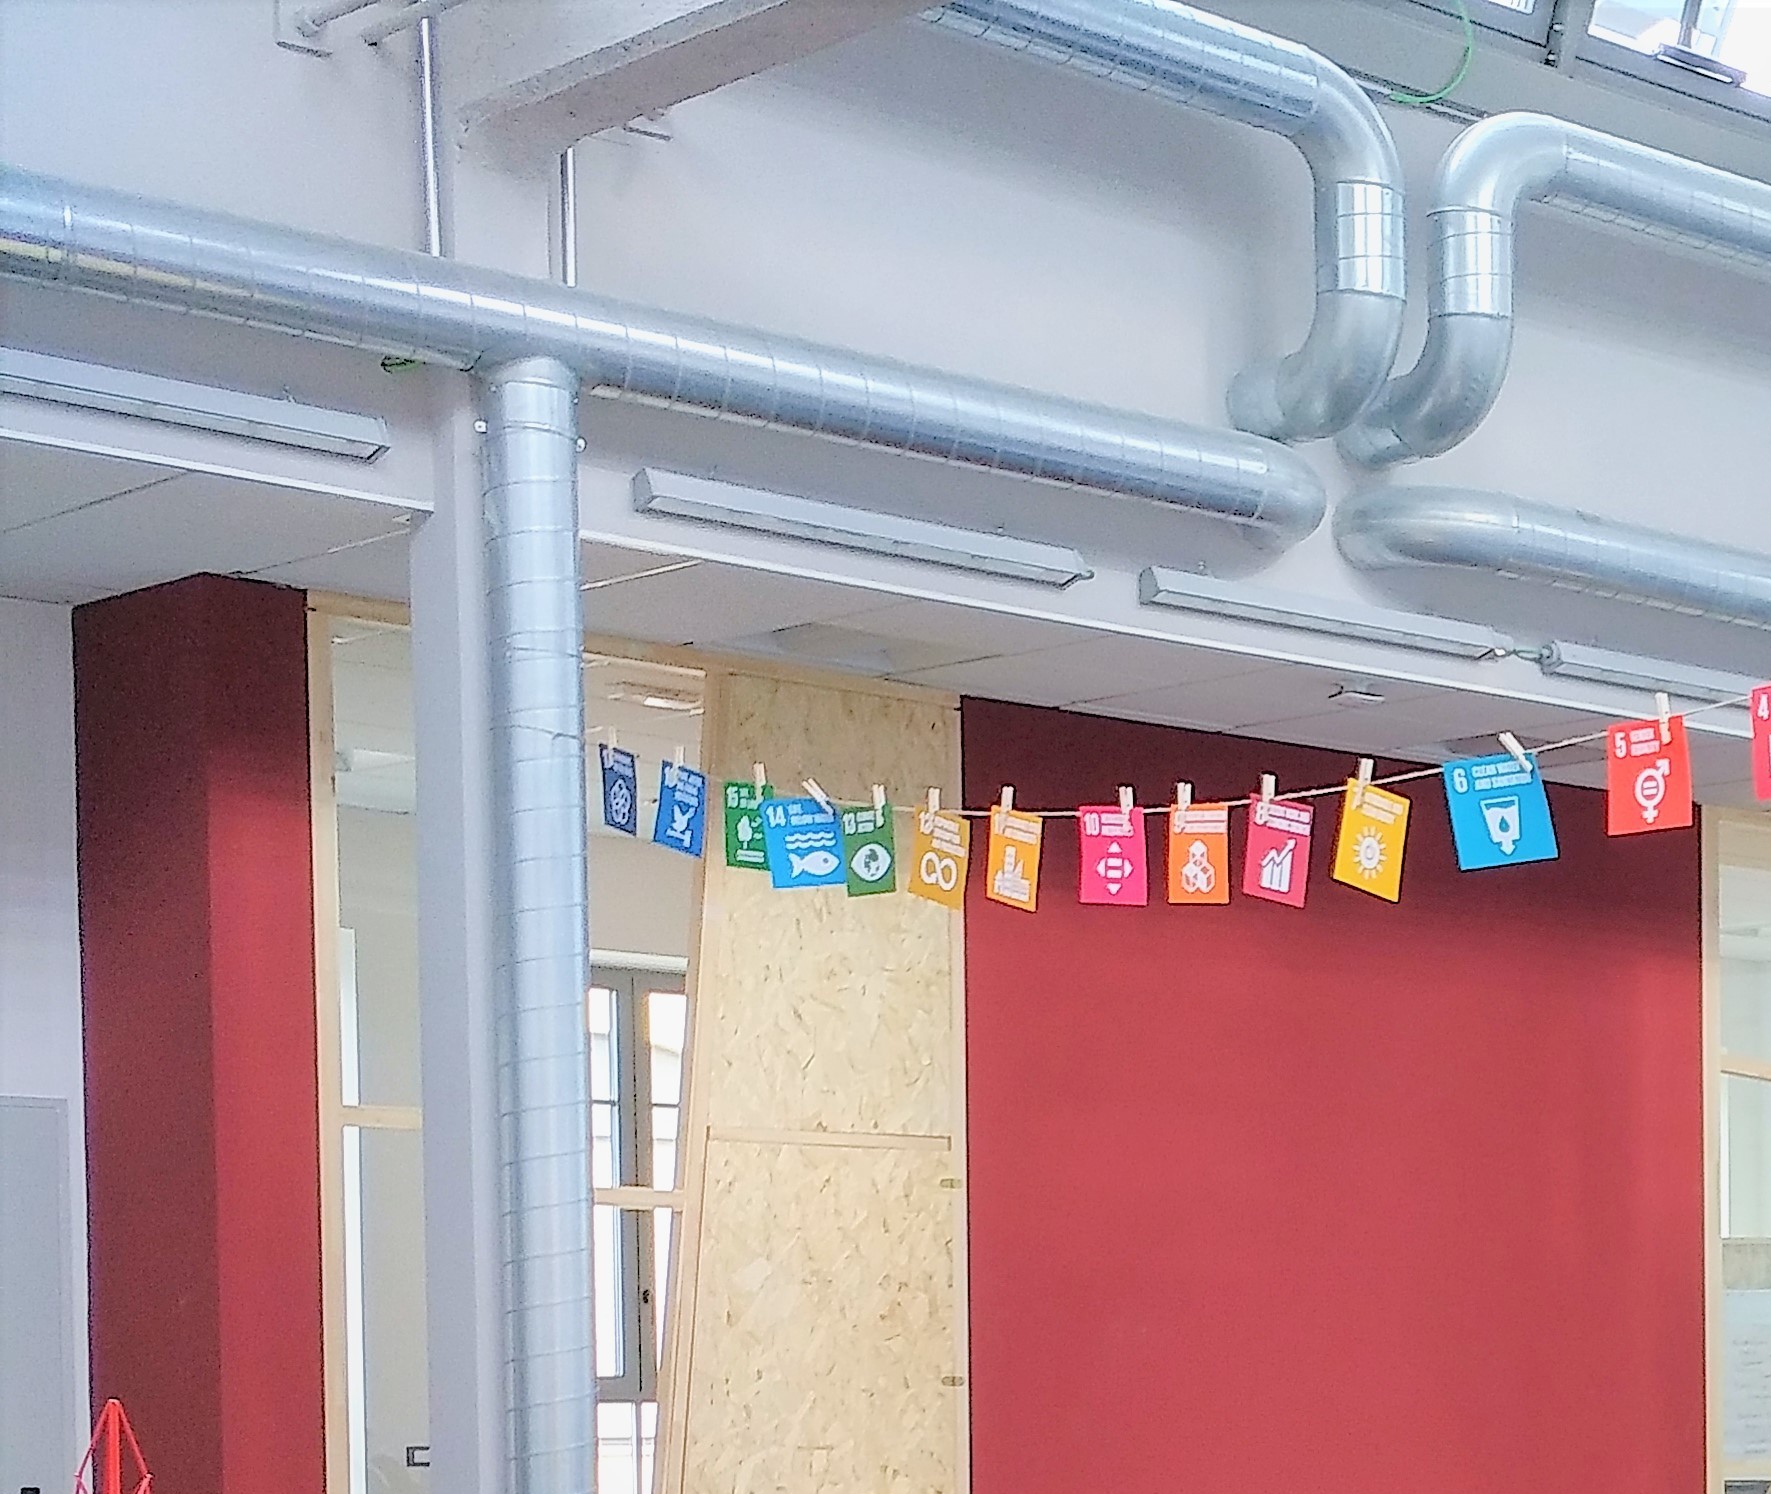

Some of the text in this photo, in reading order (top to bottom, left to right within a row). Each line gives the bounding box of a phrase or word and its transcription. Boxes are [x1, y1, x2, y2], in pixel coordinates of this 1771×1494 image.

[1757, 693, 1769, 720] 4
[1614, 731, 1627, 759] 5
[1453, 768, 1469, 794] 6
[766, 805, 787, 828] 14
[1084, 812, 1100, 836] 10
